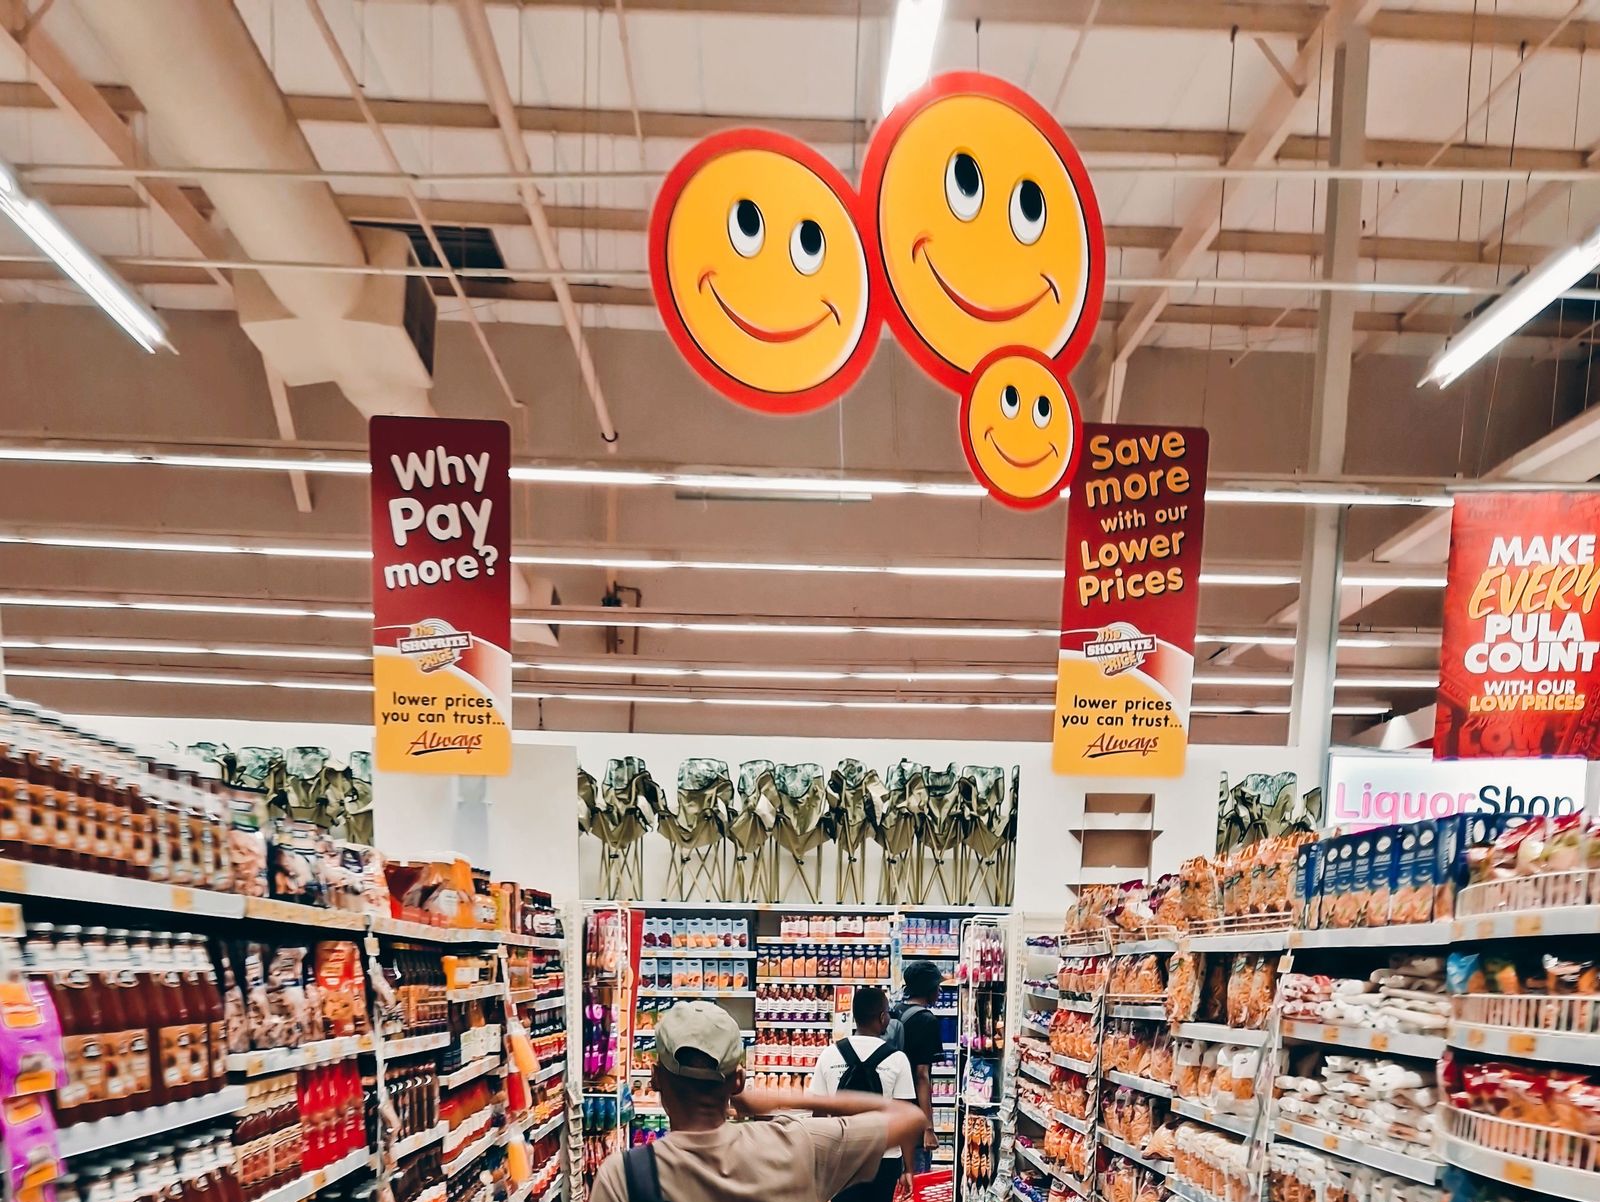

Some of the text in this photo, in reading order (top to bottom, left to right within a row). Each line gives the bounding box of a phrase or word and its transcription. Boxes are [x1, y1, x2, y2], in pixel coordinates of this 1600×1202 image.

[1090, 431, 1186, 471] Save
[390, 445, 491, 492] Why
[1085, 466, 1191, 508] more
[388, 497, 493, 550] Pay
[1101, 504, 1188, 533] with our
[1080, 530, 1185, 572] Lower
[1488, 535, 1596, 567] MAKE
[384, 545, 499, 590] more?
[1078, 566, 1184, 607] Prices
[1468, 563, 1600, 621] EVERY
[1484, 612, 1585, 643] PULA
[1086, 638, 1153, 656] SHOPRITE
[1464, 641, 1600, 674] COUNT
[392, 691, 493, 711] lower prices
[1469, 694, 1586, 712] LOW PRICES
[1484, 680, 1576, 696] WITH OUR
[382, 711, 410, 725] you
[417, 711, 446, 725] can
[1074, 695, 1172, 713] lower prices
[1062, 714, 1089, 729] you
[1096, 714, 1124, 727] can
[406, 731, 483, 756] Always
[1082, 733, 1159, 758] Always
